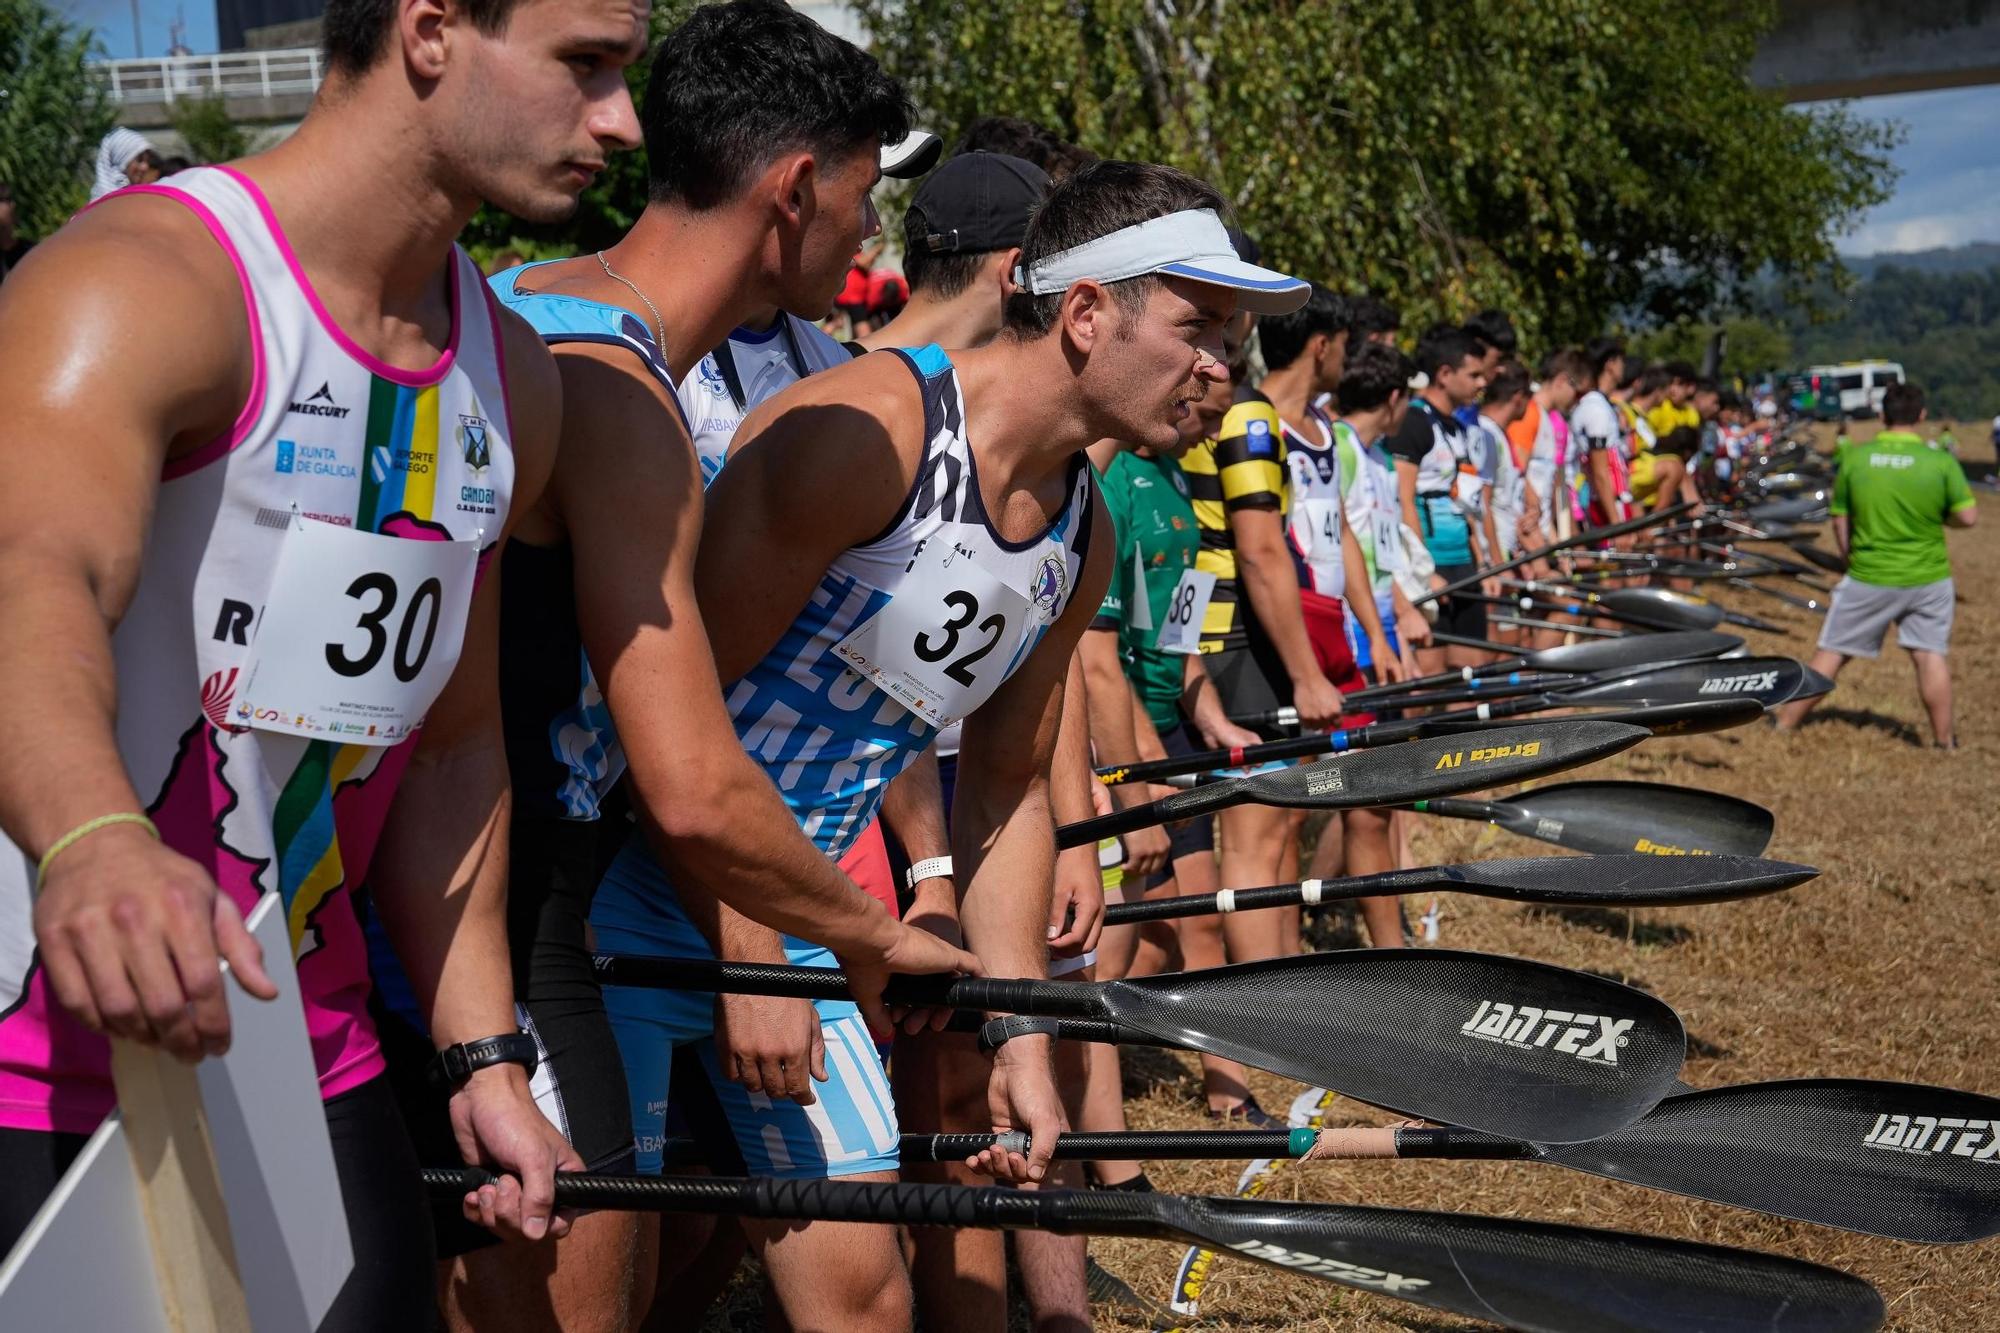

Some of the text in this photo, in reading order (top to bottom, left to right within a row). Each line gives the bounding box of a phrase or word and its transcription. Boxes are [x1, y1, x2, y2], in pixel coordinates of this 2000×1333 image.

[288, 402, 350, 419] MERCURY
[299, 446, 337, 460] XUNTA
[1870, 453, 1915, 469] RFEP
[297, 460, 357, 478] DE GALICIA
[1169, 584, 1196, 625] 38
[325, 572, 442, 682] 30
[913, 590, 1006, 688] 32
[1698, 670, 1779, 694] JANTEX
[1435, 752, 1463, 770] IV
[1308, 781, 1343, 793] canoe
[1460, 1029, 1534, 1050] PROFESSIONAL PADDLES
[1462, 1000, 1635, 1062] JANTEX
